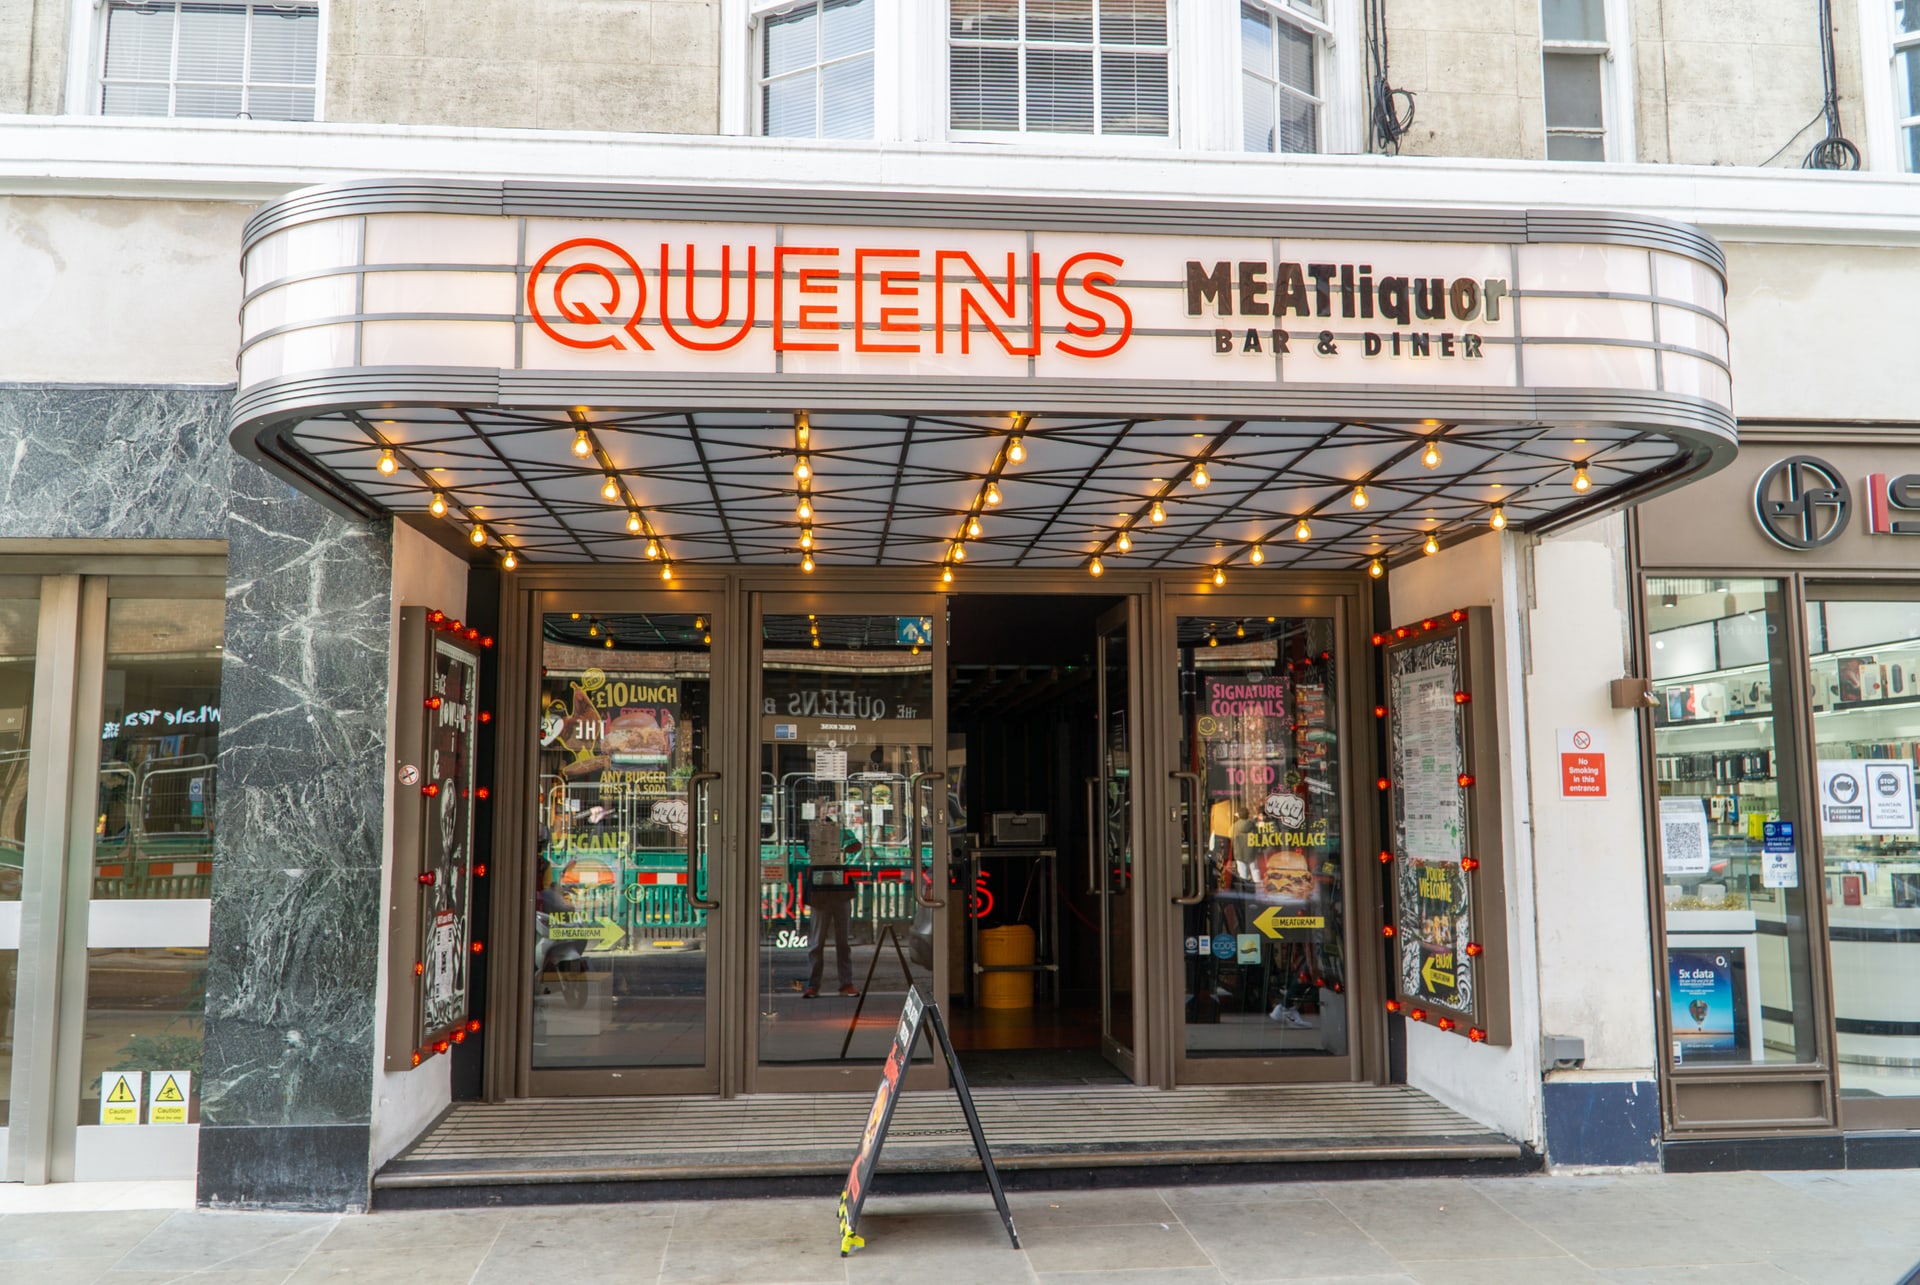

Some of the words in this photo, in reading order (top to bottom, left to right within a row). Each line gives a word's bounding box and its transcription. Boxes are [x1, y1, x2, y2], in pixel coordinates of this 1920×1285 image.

[528, 237, 1133, 358] QUEENS
[1186, 261, 1507, 325] MEATliquor
[1215, 328, 1290, 354] BAR
[1316, 330, 1338, 355] &
[1363, 331, 1483, 358] DINER
[596, 682, 629, 708] £10
[630, 684, 678, 704] LUNCH
[1212, 683, 1284, 699] SIGNATURE
[1211, 700, 1285, 717] COCKTAILS
[1578, 757, 1589, 765] No
[600, 771, 622, 783] ANY
[625, 771, 666, 783] BURGER
[1569, 766, 1599, 776] Smoking
[600, 784, 623, 793] FRIES
[644, 784, 667, 793] SODA
[1257, 821, 1275, 833] THE
[1247, 832, 1284, 847] BLACK
[1285, 832, 1327, 847] PALACE
[1419, 878, 1452, 902] WELCOME
[549, 912, 566, 925] ME
[567, 911, 588, 924] TOO
[1678, 968, 1690, 978] 5x
[1692, 968, 1715, 978] data
